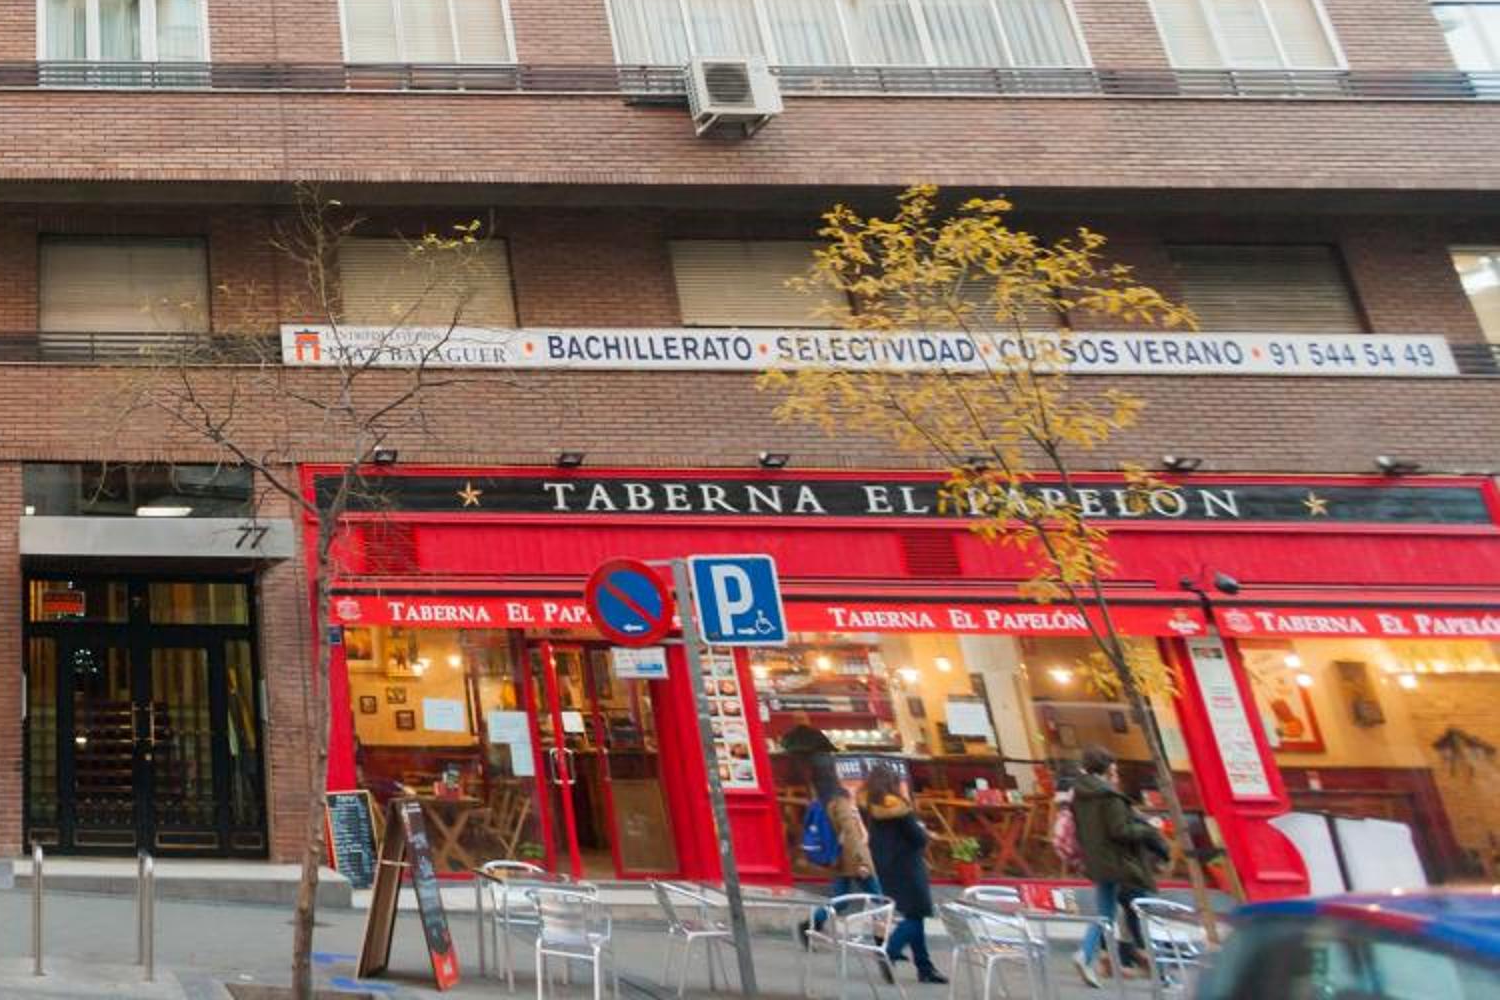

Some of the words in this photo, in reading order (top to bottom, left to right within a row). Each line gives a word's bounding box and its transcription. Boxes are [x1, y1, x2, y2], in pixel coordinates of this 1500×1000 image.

[547, 335, 753, 361] BACHILLERATO
[776, 336, 975, 362] SELECTIVIDAD
[1123, 339, 1244, 365] VERANO
[1268, 342, 1300, 366] 91
[1307, 342, 1357, 366] 544
[1363, 342, 1396, 367] 54
[1403, 343, 1435, 367] 49
[543, 481, 828, 514] TABERNA
[863, 485, 930, 515] EL
[235, 525, 269, 550] 77
[387, 601, 491, 623] TABERNA
[508, 603, 535, 623] EL
[710, 564, 754, 636] P
[827, 607, 935, 629] TABERNA
[948, 608, 978, 629] EL
[984, 608, 1089, 630] PAPELÓN
[1254, 611, 1367, 633] TABERNA
[1376, 613, 1412, 635] EL
[1413, 612, 1500, 635] PAPELÓ
